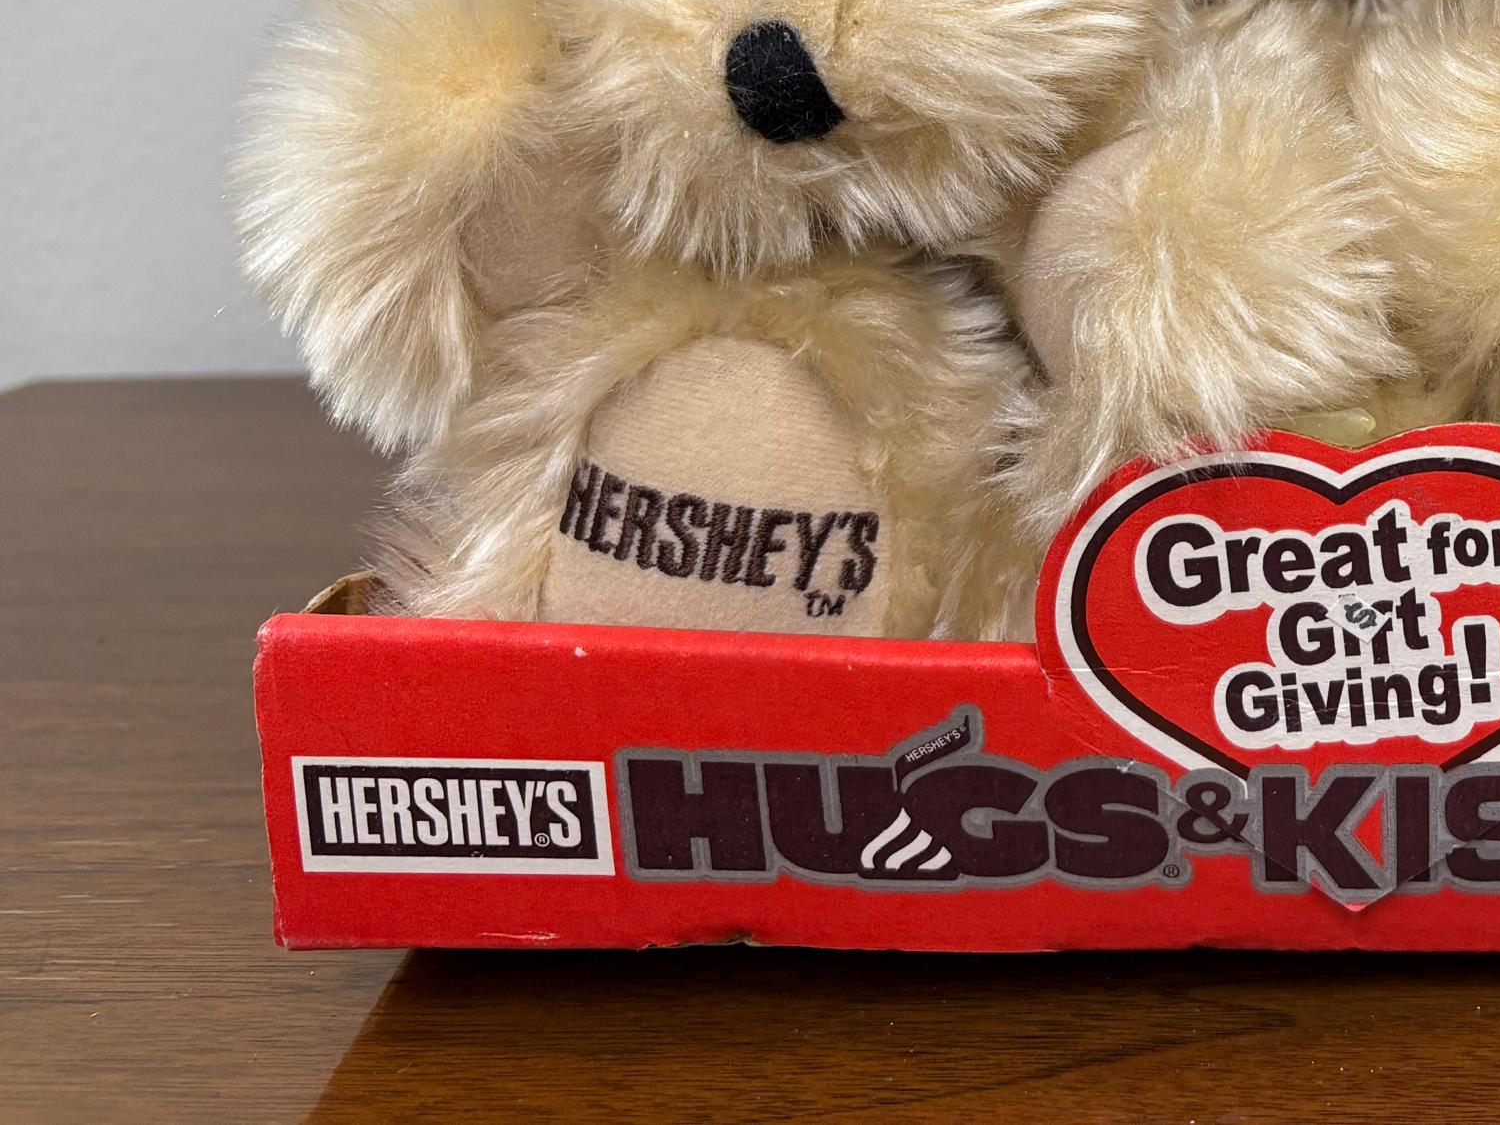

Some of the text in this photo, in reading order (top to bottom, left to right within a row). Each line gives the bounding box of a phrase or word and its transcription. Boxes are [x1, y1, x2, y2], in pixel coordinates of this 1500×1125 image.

[560, 459, 880, 594] HERSHEY'S
[1145, 507, 1412, 608] Great
[1224, 622, 1492, 734] Giving!
[904, 728, 962, 763] HERSHEY'S
[318, 776, 582, 848] HERSHEY'S
[625, 757, 1170, 880] HUGS
